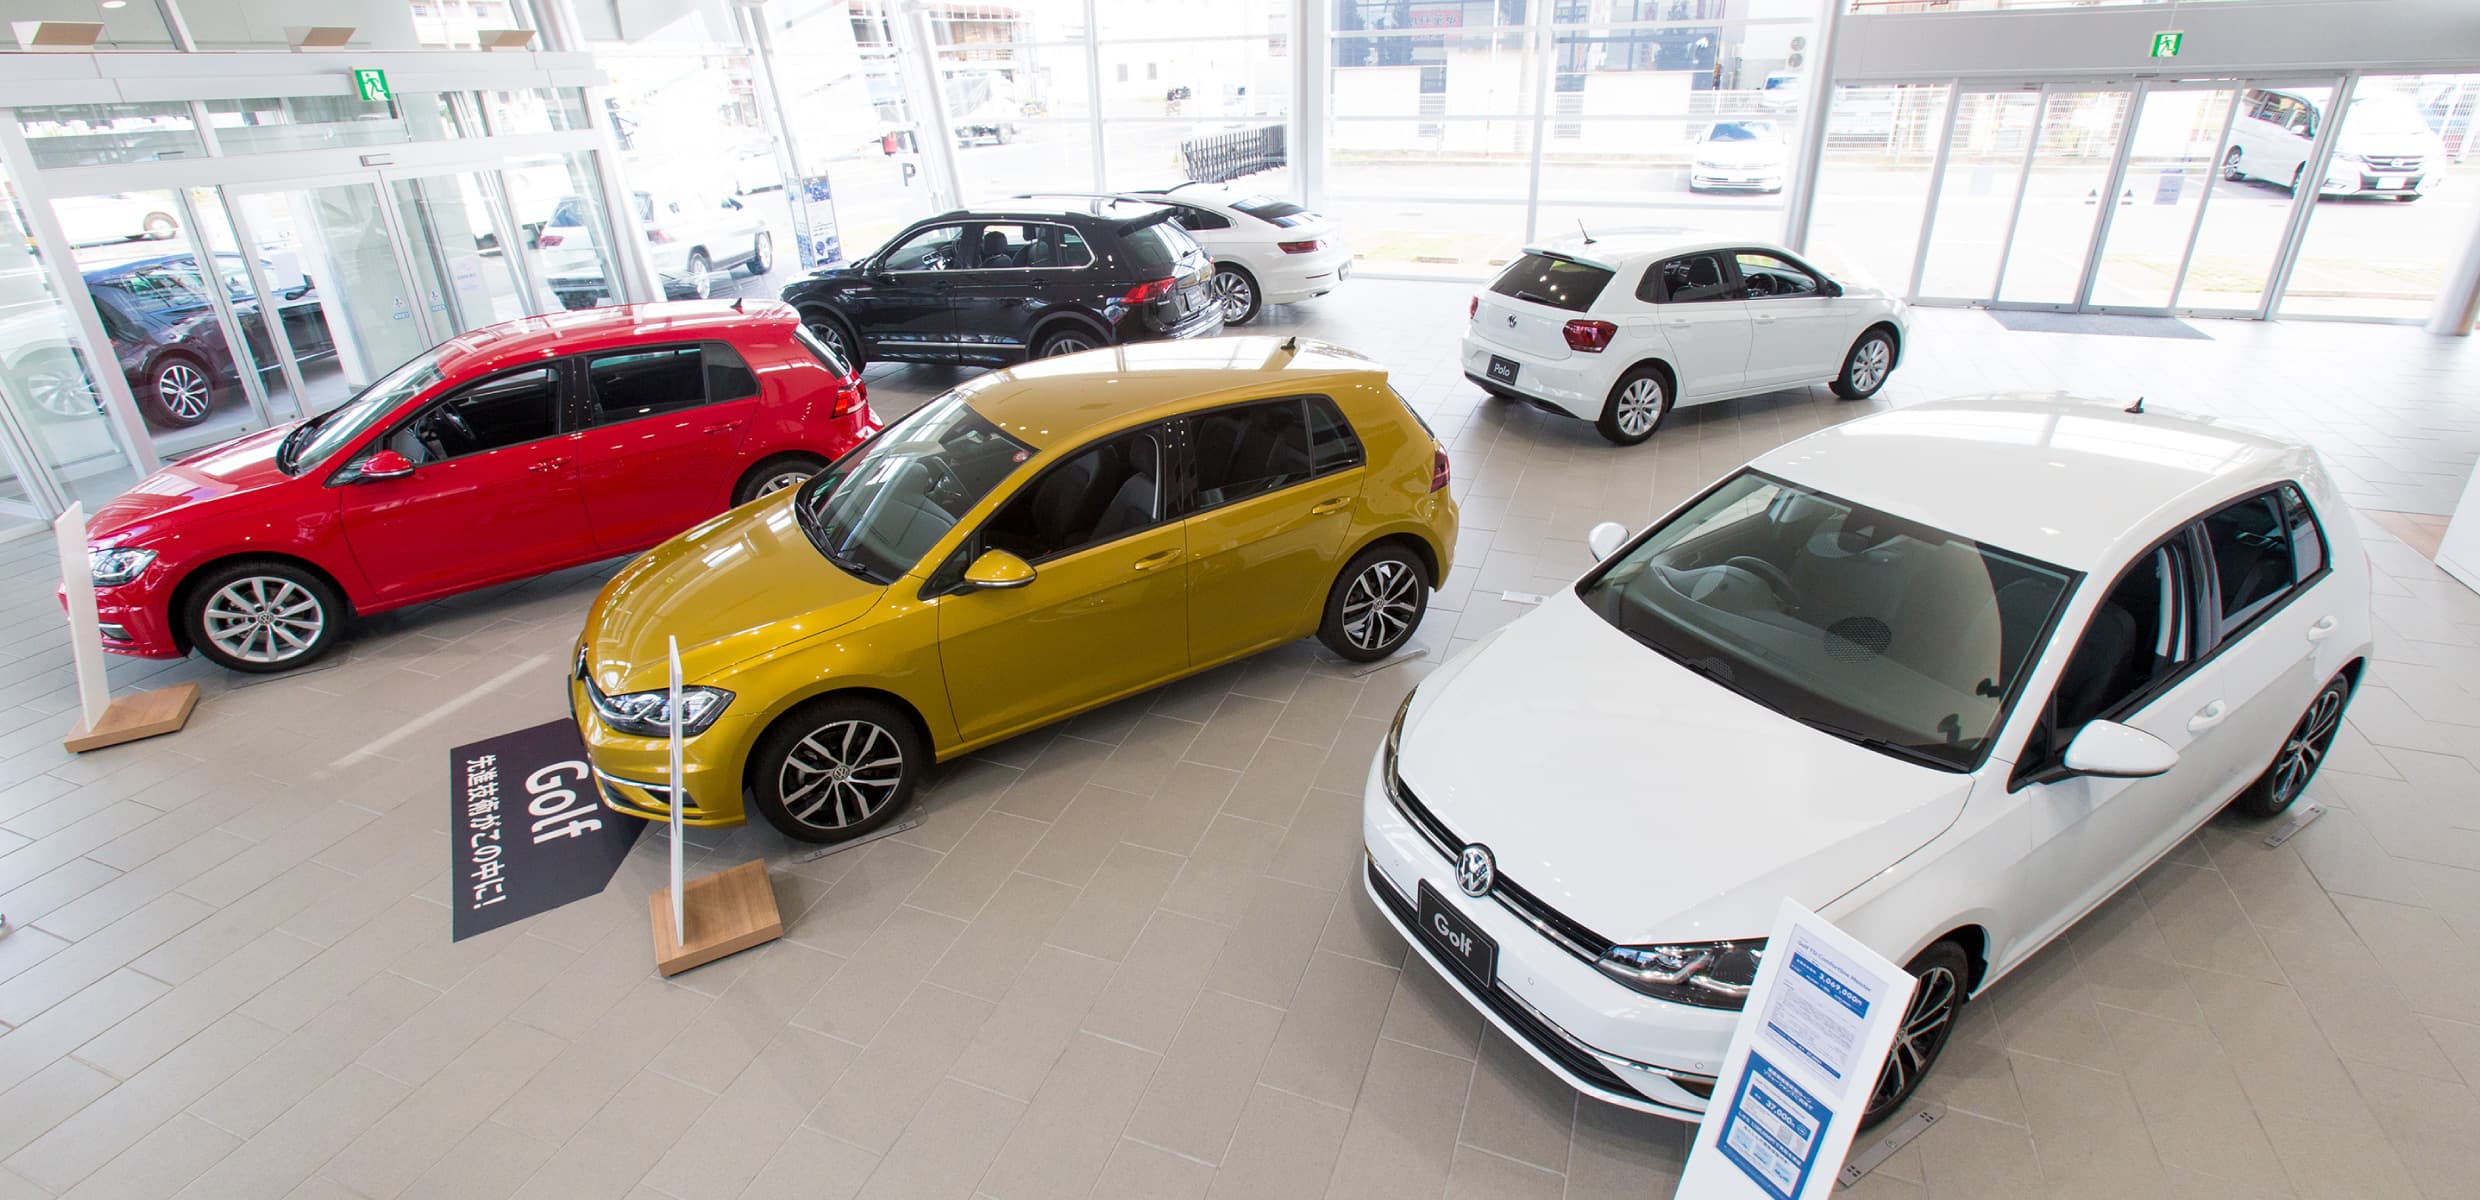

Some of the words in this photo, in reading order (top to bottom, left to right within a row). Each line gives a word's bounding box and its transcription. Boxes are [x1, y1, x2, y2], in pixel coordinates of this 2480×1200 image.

[901, 162, 916, 187] P
[1493, 363, 1511, 377] Polo
[525, 760, 602, 845] Golf
[1434, 912, 1473, 957] Golf
